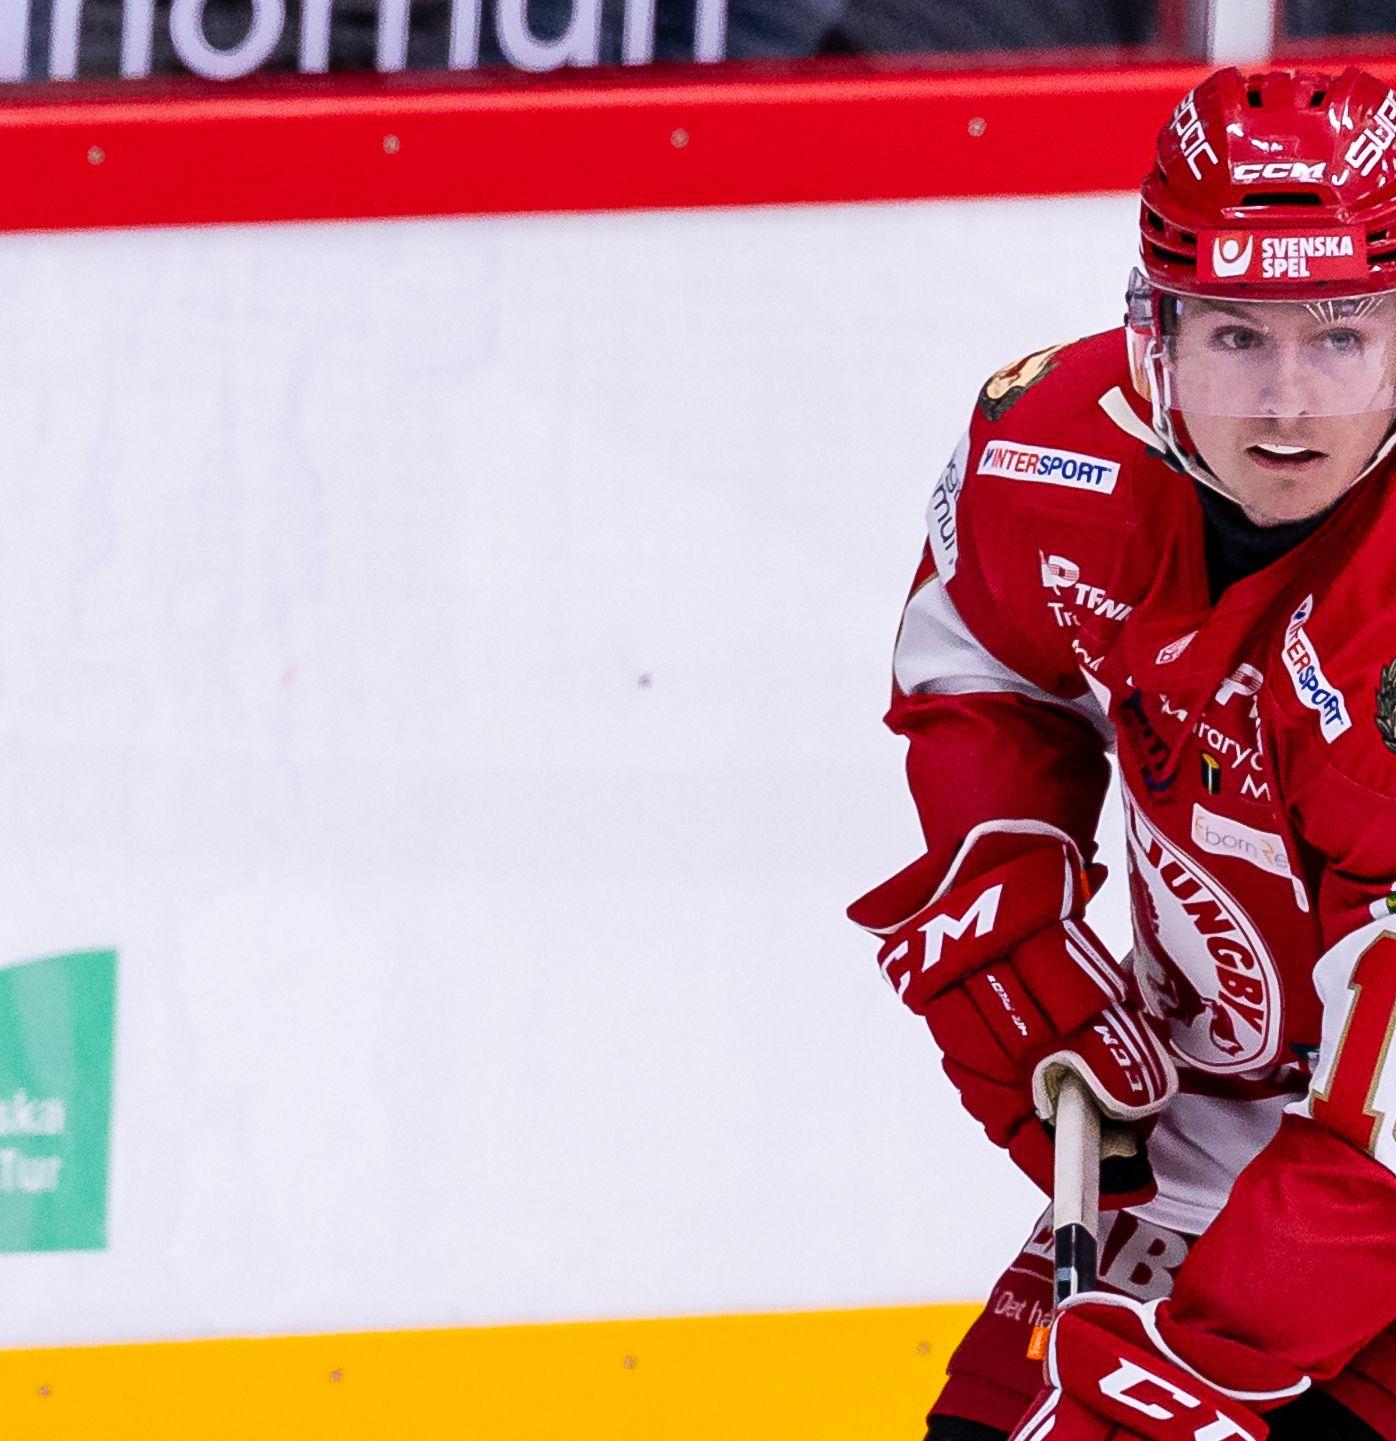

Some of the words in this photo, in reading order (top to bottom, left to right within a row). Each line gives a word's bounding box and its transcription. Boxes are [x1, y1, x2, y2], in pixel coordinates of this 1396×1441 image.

[1233, 162, 1327, 182] CCM
[1262, 235, 1354, 258] SVENSKA
[1261, 257, 1311, 279] SPEL
[985, 447, 1112, 487] INTERSPORT
[1093, 1024, 1143, 1092] CCM
